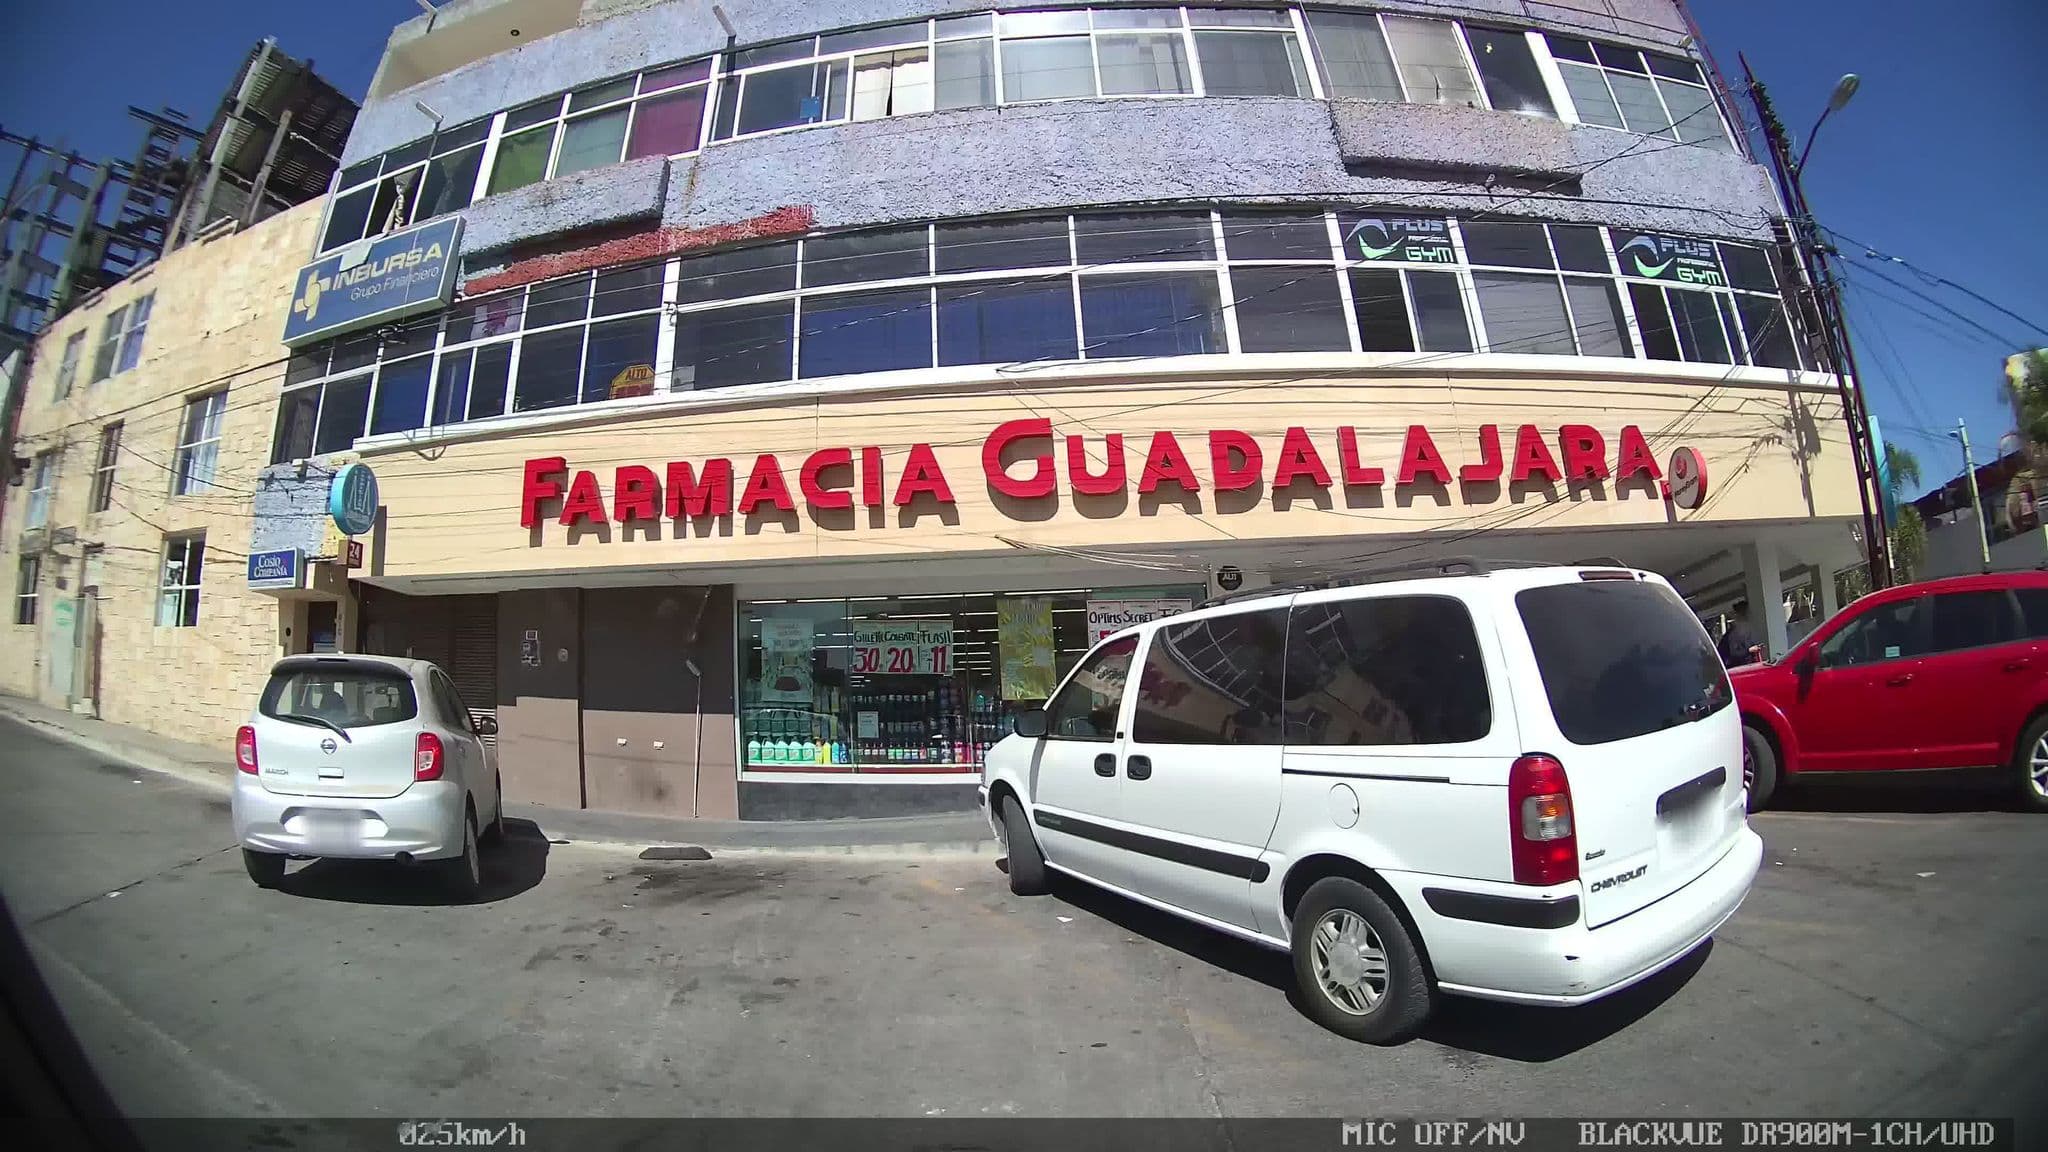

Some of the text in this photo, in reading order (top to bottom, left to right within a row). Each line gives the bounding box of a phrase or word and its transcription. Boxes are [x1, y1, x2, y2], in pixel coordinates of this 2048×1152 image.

[1405, 246, 1455, 262] GYM
[1660, 237, 1712, 257] PLUS
[332, 242, 443, 291] INBURSA
[1677, 266, 1722, 285] GYM
[350, 266, 440, 301] Grupo Financiero
[520, 417, 1663, 529] FARMACIA GUADALAJARA
[853, 646, 881, 673] 30
[887, 646, 914, 673] 20
[930, 645, 948, 673] 11
[1591, 864, 1648, 893] CHEVROLET
